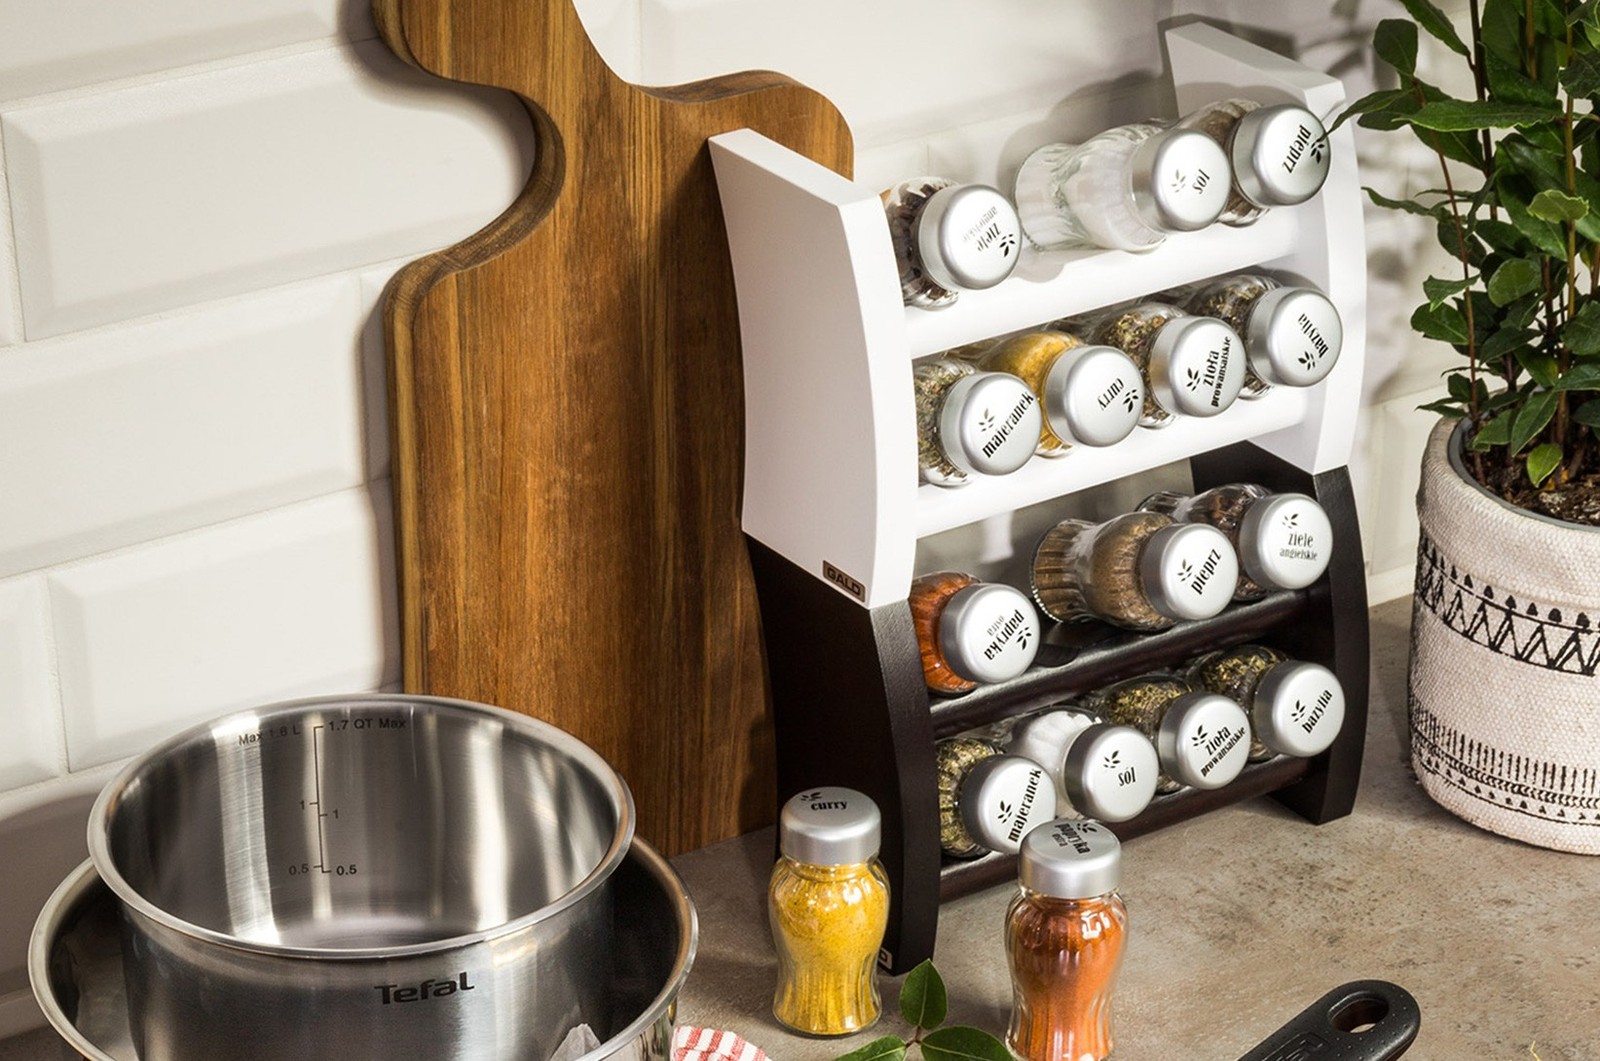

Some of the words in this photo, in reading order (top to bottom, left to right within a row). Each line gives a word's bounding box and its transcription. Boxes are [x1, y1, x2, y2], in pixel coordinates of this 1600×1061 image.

[1282, 124, 1312, 173] pieprz
[1297, 313, 1329, 359] bazylia
[1203, 350, 1220, 387] zioła
[1210, 336, 1232, 408] prowansalskie
[1097, 377, 1125, 411] curry
[982, 391, 1035, 458] majeranek
[1279, 548, 1318, 562] angielskie
[1287, 533, 1314, 548] ziele
[1191, 548, 1222, 596] pieprz
[984, 609, 1025, 661] papryka
[329, 719, 349, 731] 1.7
[354, 718, 373, 729] QT
[379, 718, 407, 729] Max
[1302, 689, 1333, 734] bazylia
[238, 731, 263, 746] Max
[1200, 727, 1246, 777] prowansalskie
[1205, 725, 1232, 756] zioła
[1118, 766, 1136, 787] sól
[811, 800, 848, 812] curry
[1008, 768, 1042, 843] majeranek
[1054, 823, 1092, 854] papryka
[288, 863, 309, 876] 0.5
[336, 864, 357, 876] 0.5
[374, 972, 475, 1005] Tefal
